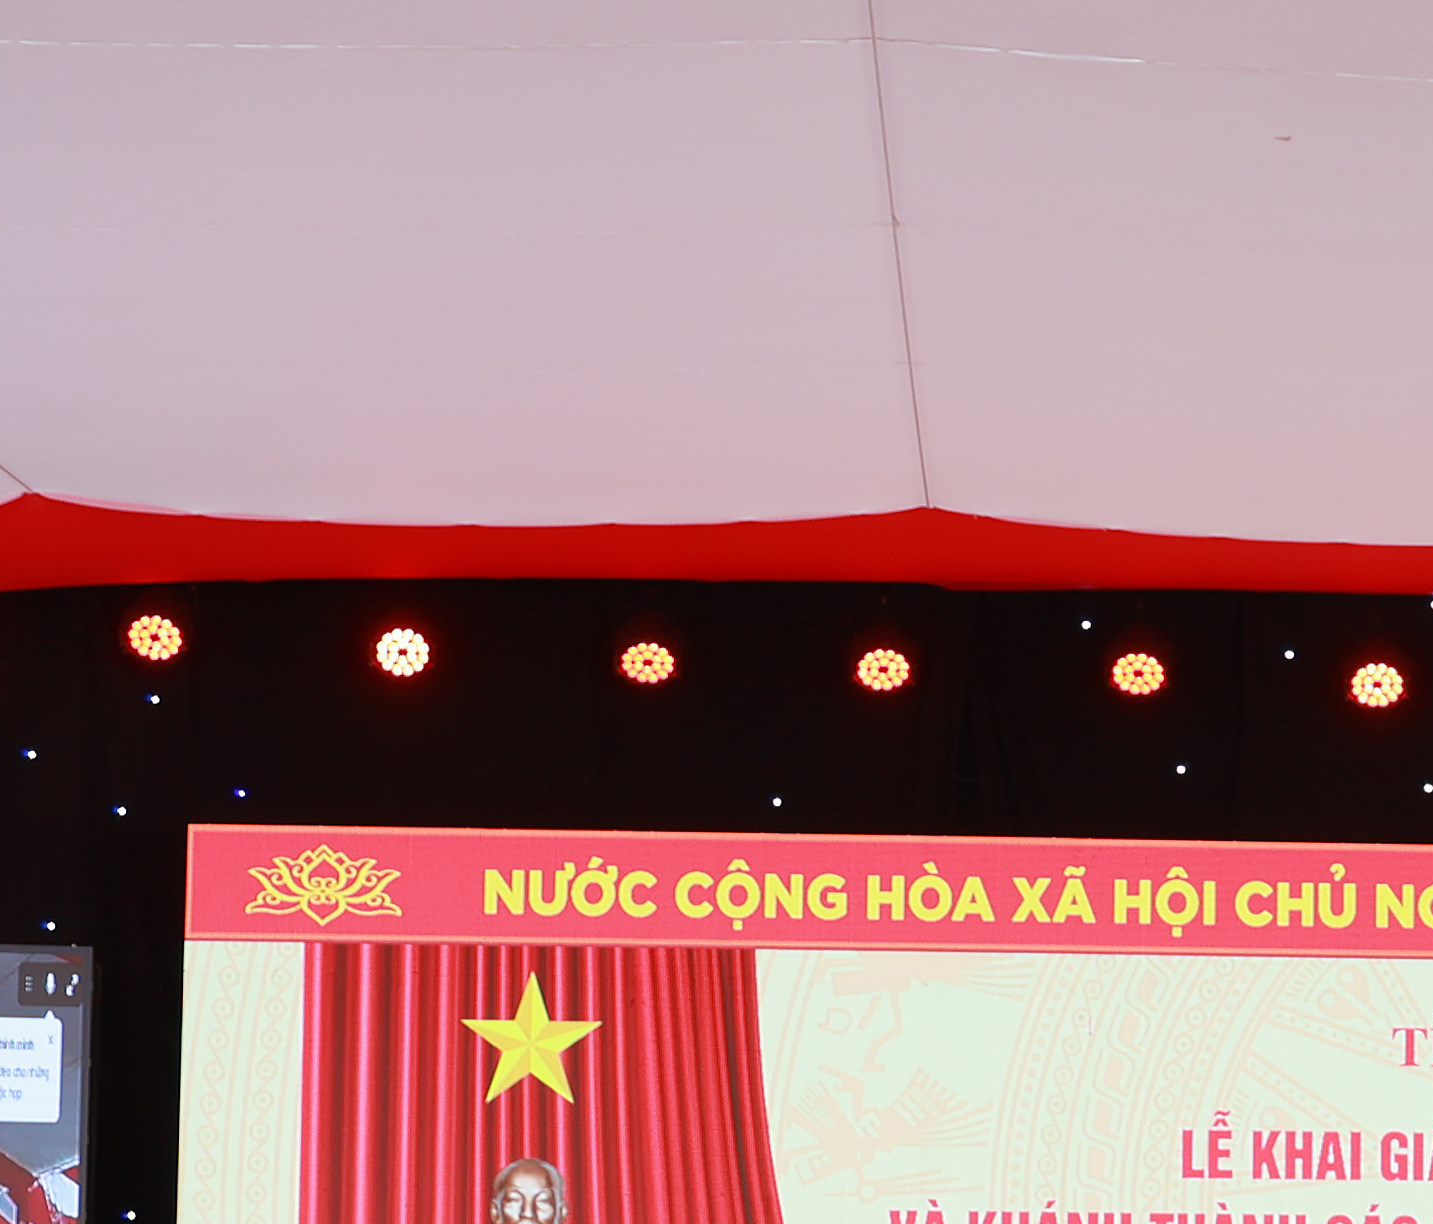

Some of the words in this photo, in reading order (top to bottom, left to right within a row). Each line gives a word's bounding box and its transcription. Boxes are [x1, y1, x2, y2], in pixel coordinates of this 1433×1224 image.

[483, 860, 657, 917] NƯỚC
[675, 861, 847, 929] CỘNG
[867, 863, 995, 922] HÒA
[1012, 867, 1096, 923] XÃ
[1114, 867, 1216, 937] HỘI
[1235, 864, 1356, 928] CHỦ
[1182, 1111, 1234, 1180] LỄ
[1252, 1130, 1362, 1182] KHAI
